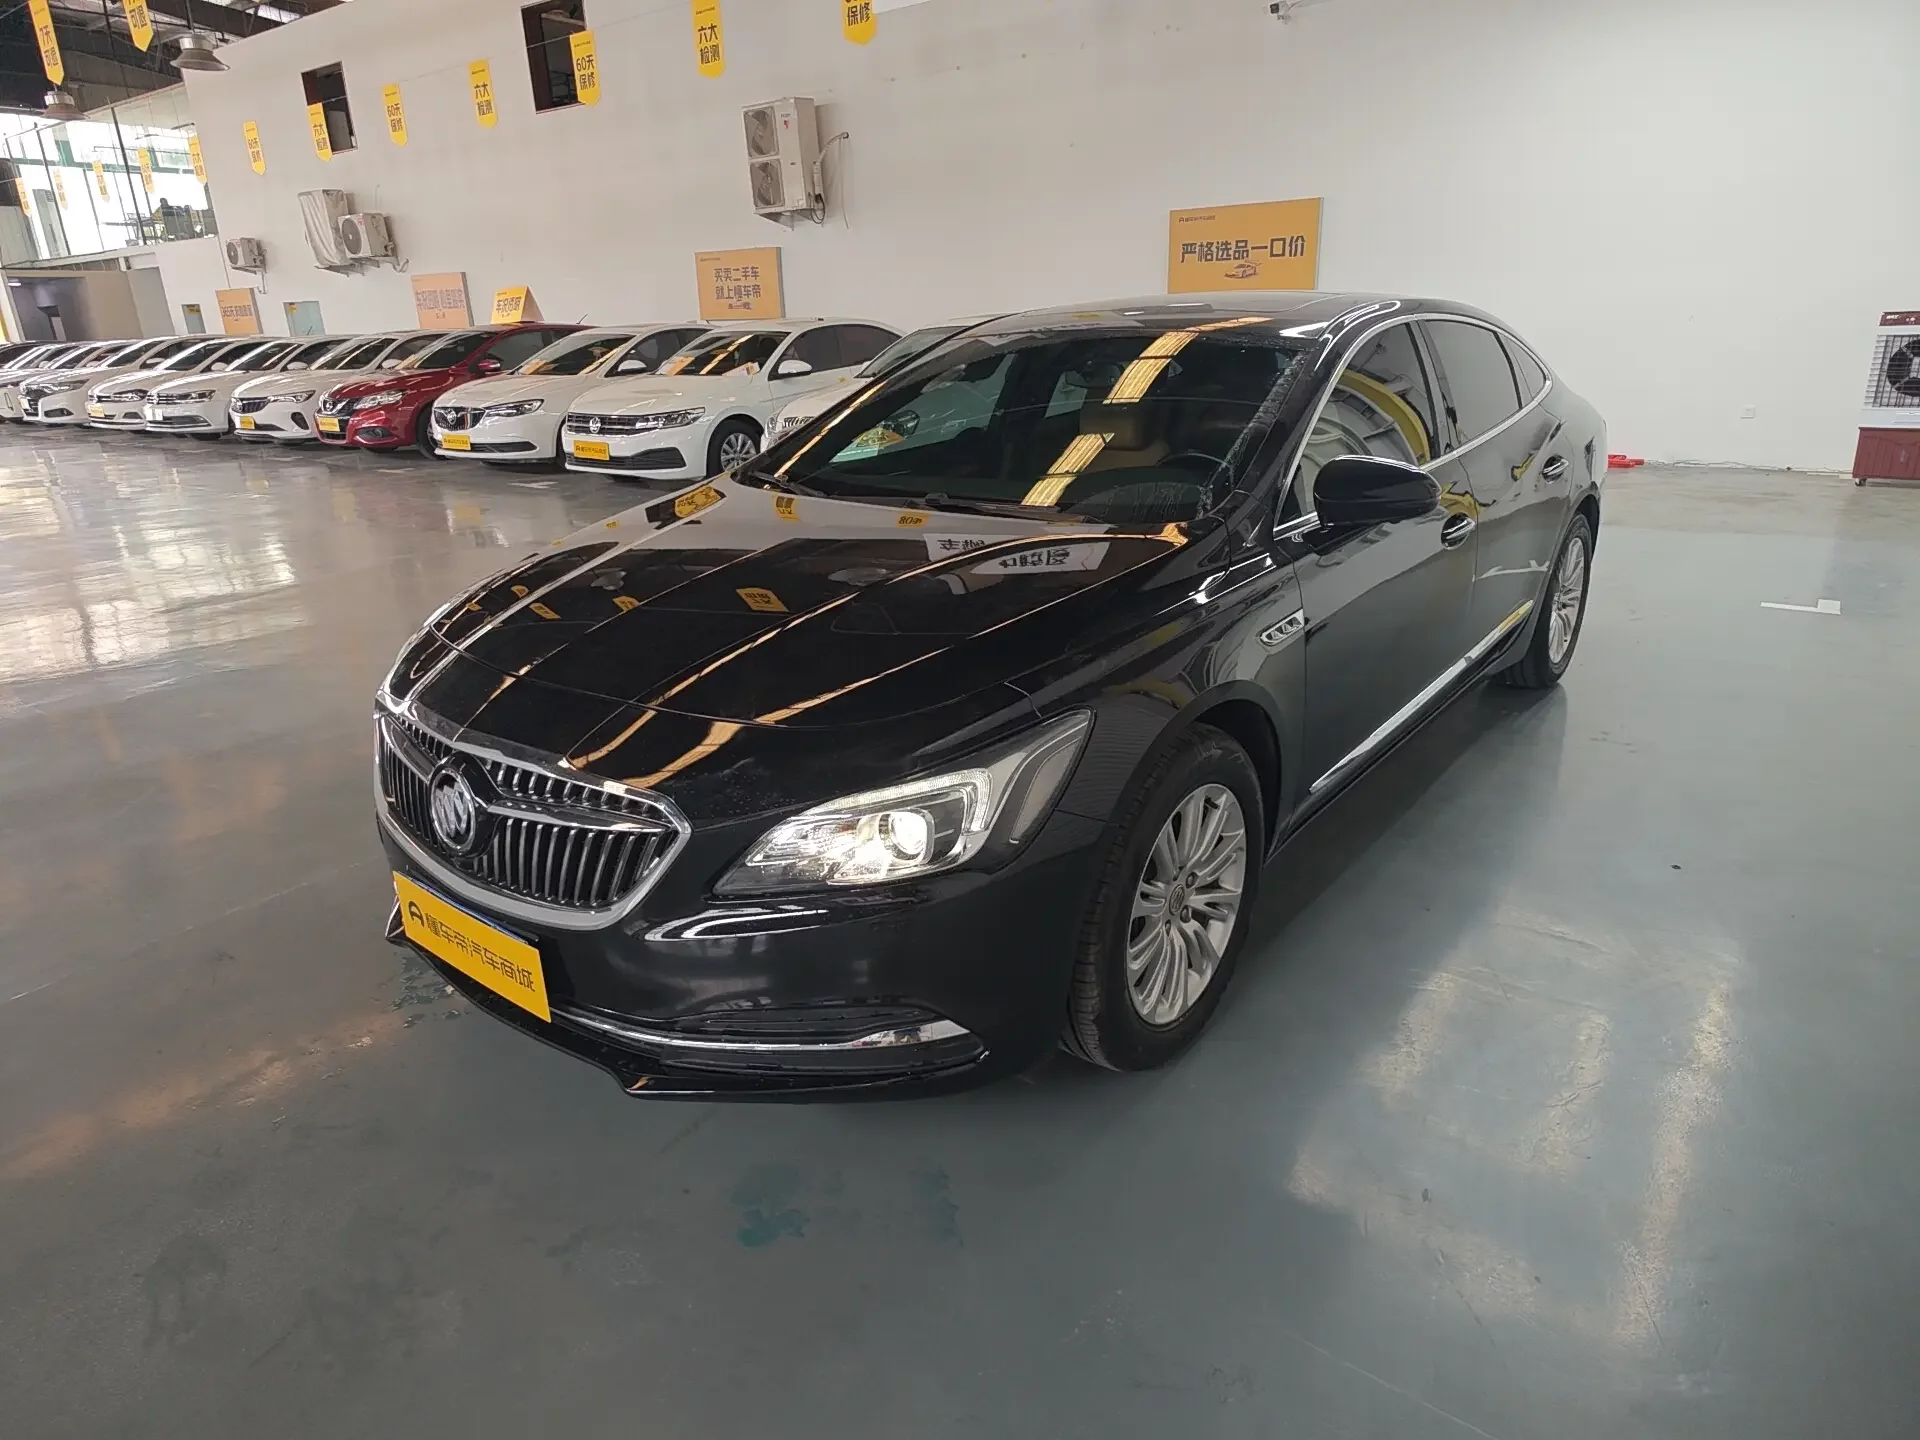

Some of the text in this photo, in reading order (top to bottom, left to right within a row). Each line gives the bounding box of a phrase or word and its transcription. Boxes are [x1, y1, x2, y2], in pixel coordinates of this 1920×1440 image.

[847, 2, 871, 26] 保修
[698, 23, 718, 44] 六大
[576, 54, 595, 72] 60天
[700, 44, 721, 65] 检测
[474, 81, 490, 99] 六大
[579, 73, 596, 90] 保修
[387, 103, 402, 117] 60天
[313, 122, 326, 137] 六大
[1180, 235, 1306, 263] 严格选品一口价
[714, 266, 760, 282] 买卖二手车
[715, 284, 761, 300] 就上懂车帝
[425, 911, 536, 993] 懂车帝汽车商城
